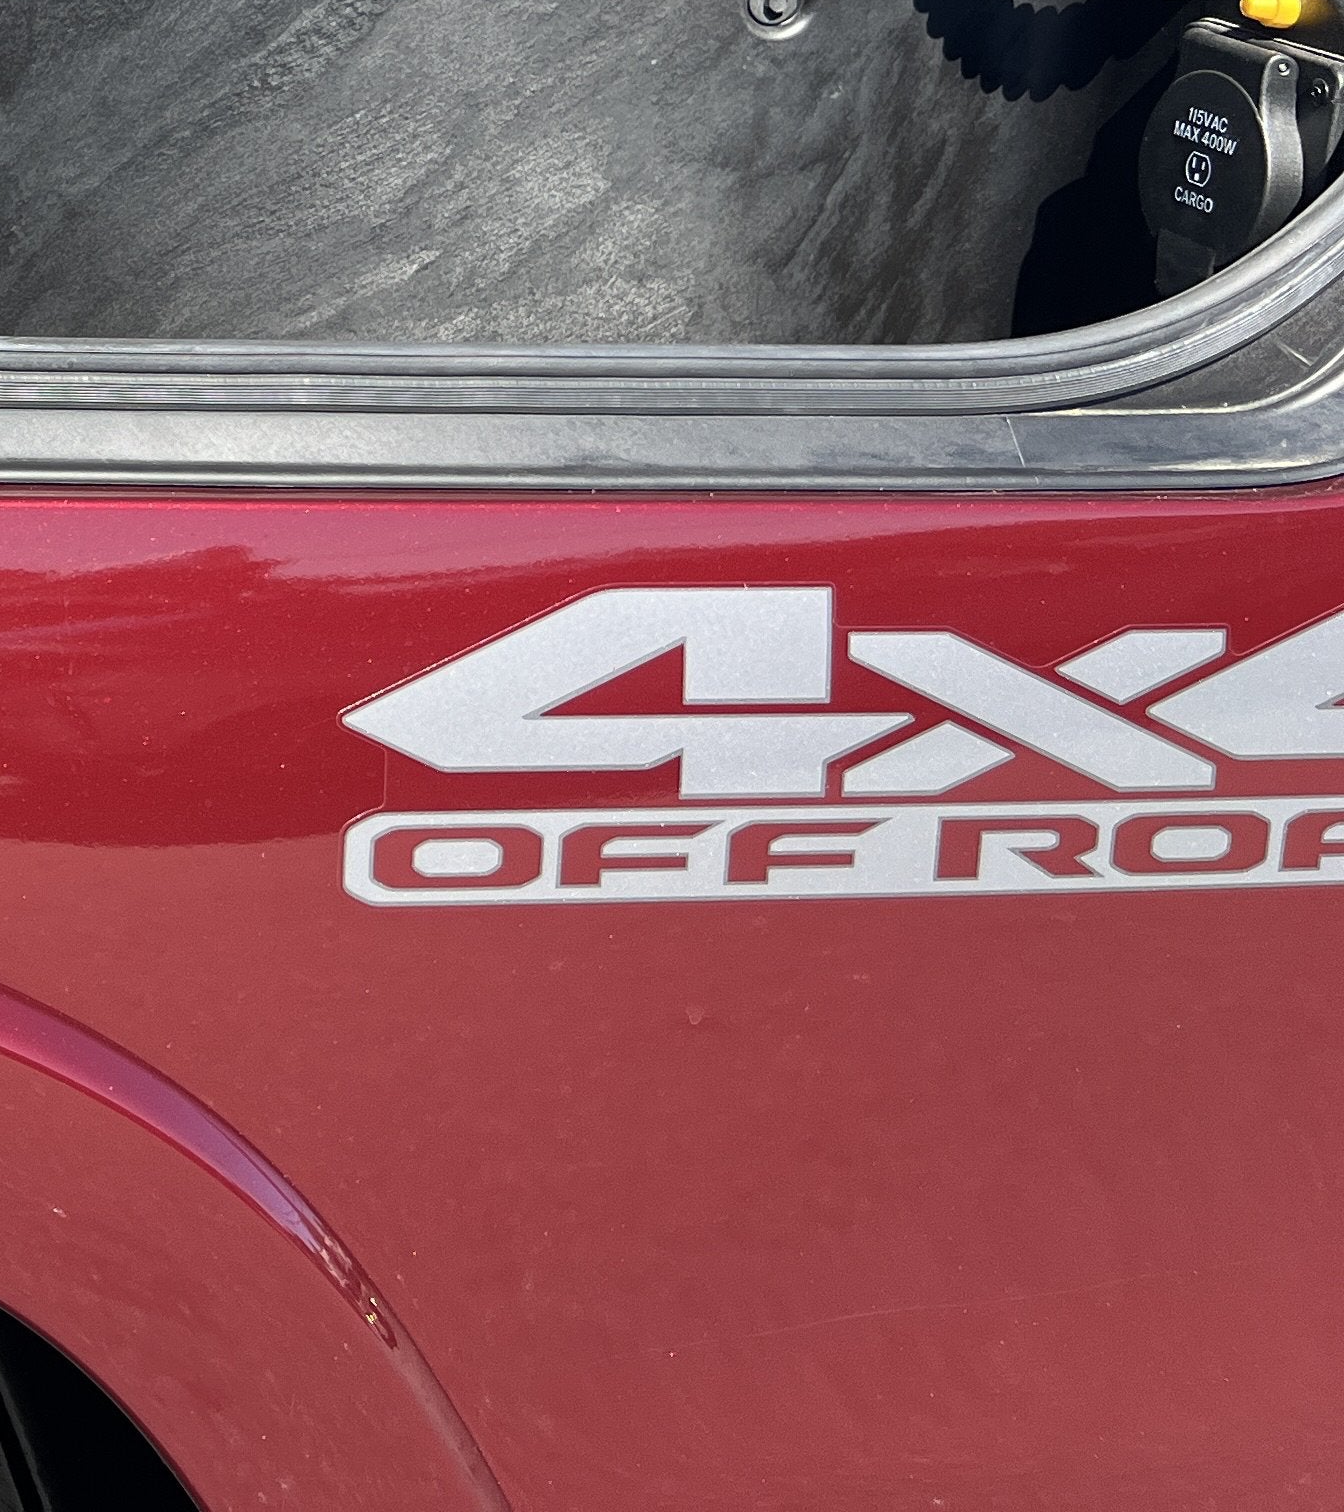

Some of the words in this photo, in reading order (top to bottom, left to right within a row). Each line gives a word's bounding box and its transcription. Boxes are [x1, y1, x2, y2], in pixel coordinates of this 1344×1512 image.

[1188, 107, 1229, 134] 115VAC
[1173, 120, 1201, 144] MAX
[1201, 131, 1238, 156] 400W
[1174, 186, 1214, 213] CARGO
[368, 816, 891, 892] OFF
